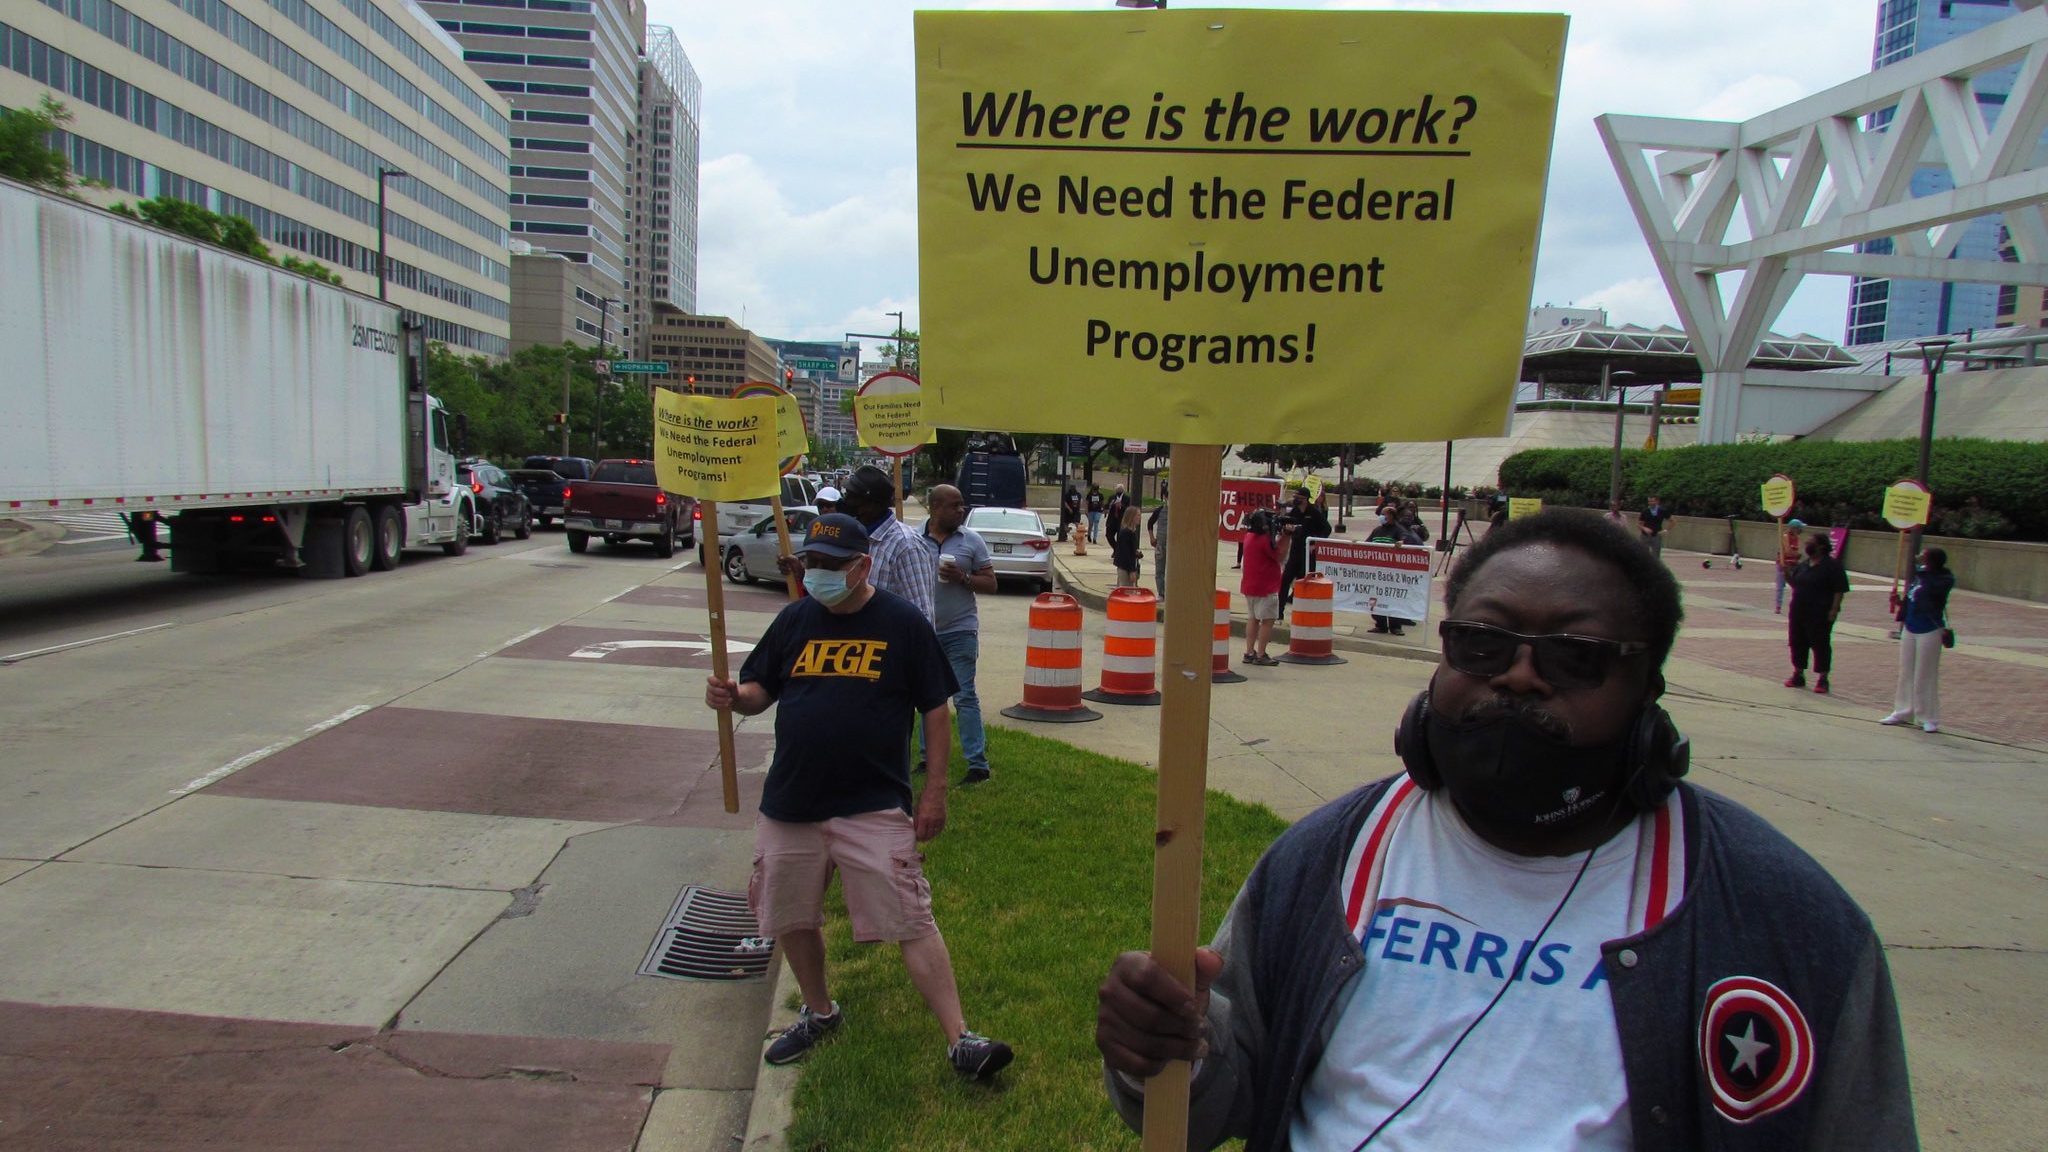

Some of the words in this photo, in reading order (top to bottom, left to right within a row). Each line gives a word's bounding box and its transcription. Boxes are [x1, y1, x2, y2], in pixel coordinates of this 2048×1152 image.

[963, 91, 1130, 140] Where
[1145, 92, 1185, 142] is
[1204, 92, 1290, 143] the
[1309, 95, 1477, 145] work?
[967, 172, 1041, 214] We
[1057, 175, 1174, 219] Need
[1189, 177, 1266, 221] the
[1282, 178, 1455, 222] Federal
[1029, 246, 1385, 303] Unemployment
[1086, 319, 1316, 372] Programs!
[798, 361, 820, 369] SHARP
[659, 407, 681, 424] Where
[684, 414, 691, 425] is
[694, 416, 713, 429] the
[718, 415, 758, 430] work?
[870, 421, 918, 429] Unemployment
[660, 427, 669, 439] We
[670, 432, 691, 444] Need
[694, 435, 709, 446] the
[713, 434, 757, 448] Federal
[879, 430, 911, 439] Programs!
[667, 447, 742, 465] Unemployment
[678, 466, 727, 482] Programs!
[818, 525, 840, 537] AFGE
[1318, 546, 1352, 558] ATTENTION
[1395, 553, 1429, 565] WORKERS
[1325, 566, 1338, 576] JOIN
[1377, 571, 1394, 582] Back
[1396, 574, 1401, 583] 2
[1336, 582, 1351, 592] Text
[1376, 587, 1384, 595] to
[1385, 588, 1408, 598] 877877
[791, 639, 888, 679] AFGE
[1534, 807, 1567, 824] JOHNS
[1362, 907, 1572, 986] FERRIS
